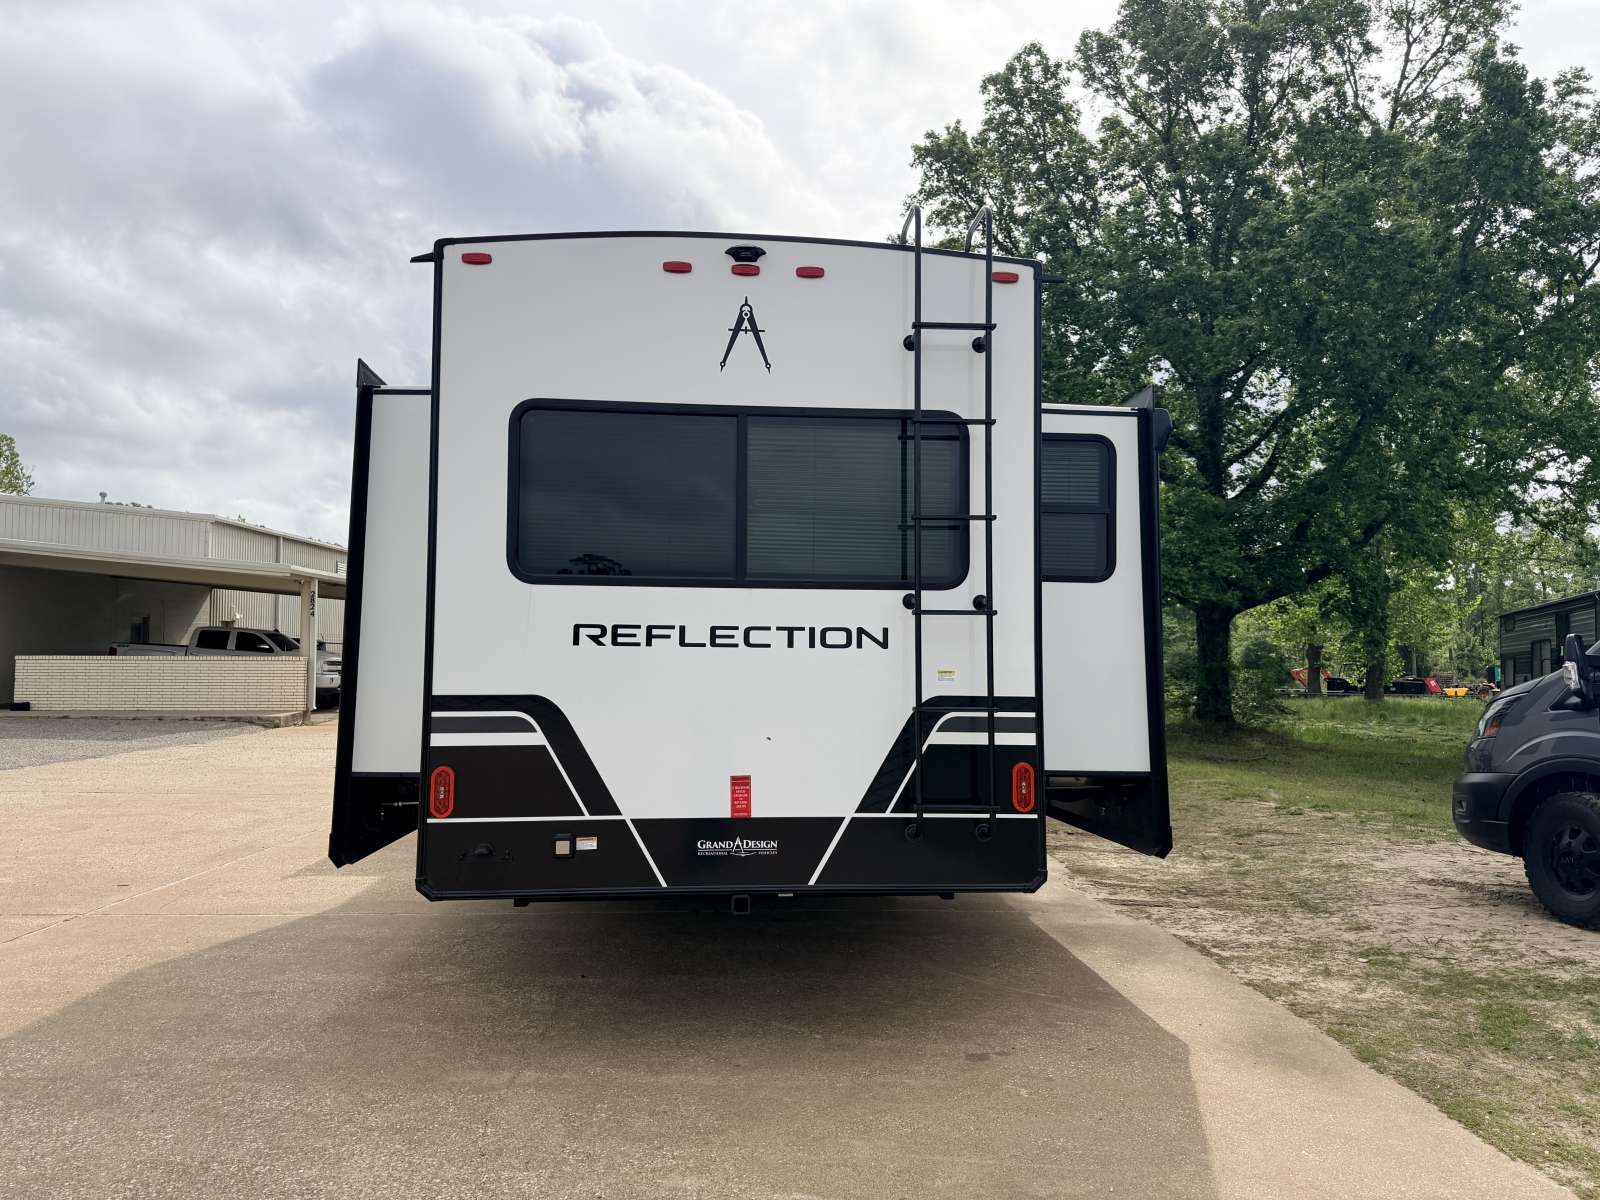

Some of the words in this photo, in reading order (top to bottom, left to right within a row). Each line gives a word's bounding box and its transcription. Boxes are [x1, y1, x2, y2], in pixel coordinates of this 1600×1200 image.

[572, 623, 889, 650] REFLECTION
[697, 839, 734, 849] GRAND
[743, 839, 778, 849] DESIGN
